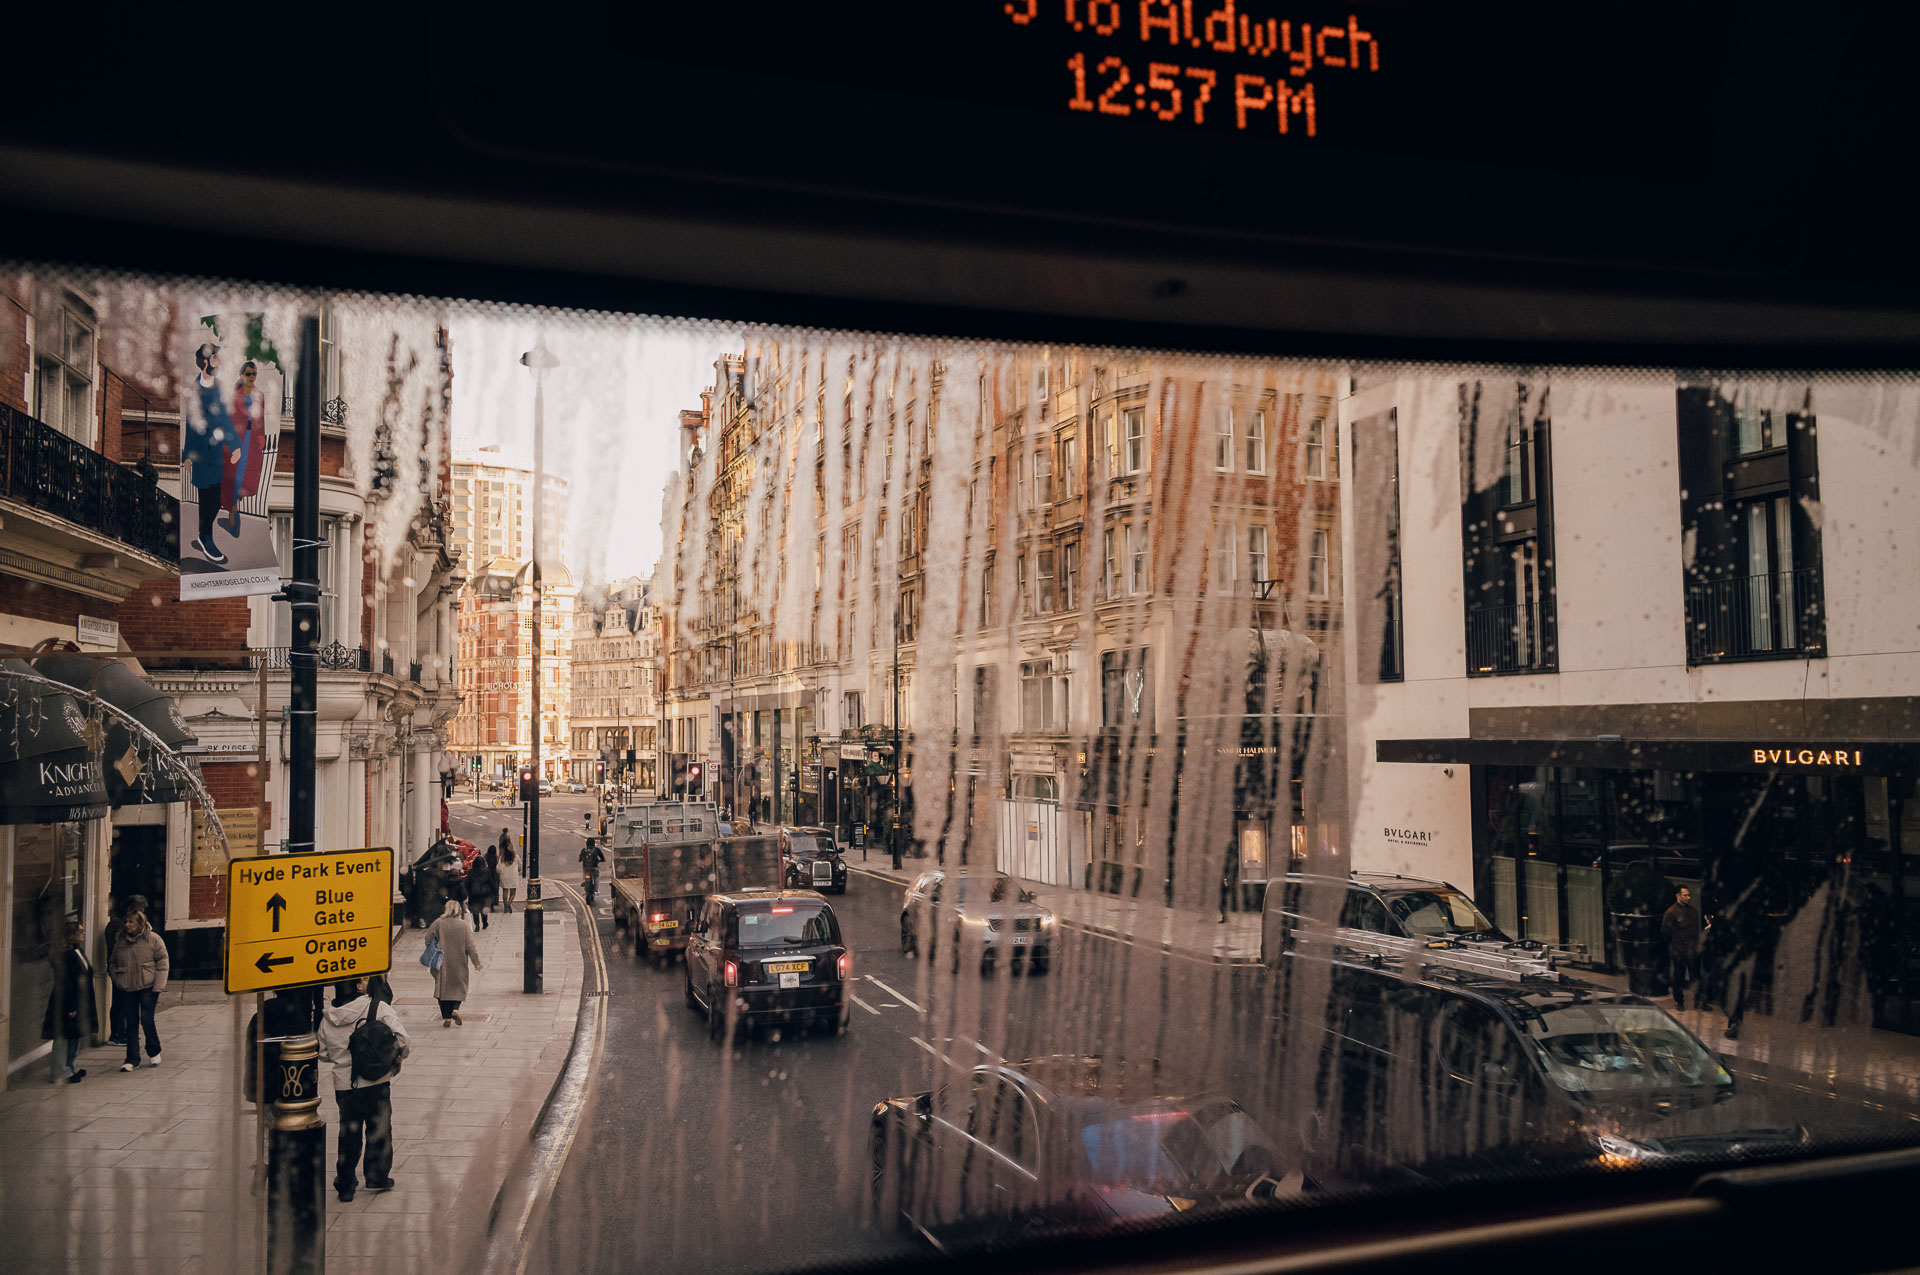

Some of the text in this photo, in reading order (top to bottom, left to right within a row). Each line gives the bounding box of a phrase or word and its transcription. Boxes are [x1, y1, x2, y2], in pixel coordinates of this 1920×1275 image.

[1139, 0, 1380, 76] Aldwych
[1067, 52, 1318, 137] 12:57 PM
[190, 575, 271, 589] KNIGHTSBRIDGELDN.CO.UK
[488, 658, 515, 666] HARVEY
[485, 682, 518, 690] NICHOLS
[1753, 749, 1862, 766] BVLGARI
[1384, 827, 1431, 842] BVLGARI
[240, 858, 382, 886] Hyde Park Event
[315, 889, 354, 905] Blue
[314, 909, 355, 926] Gate
[305, 936, 367, 955] Orange
[316, 957, 357, 974] Gate
[770, 962, 806, 972] LG74 XCF
